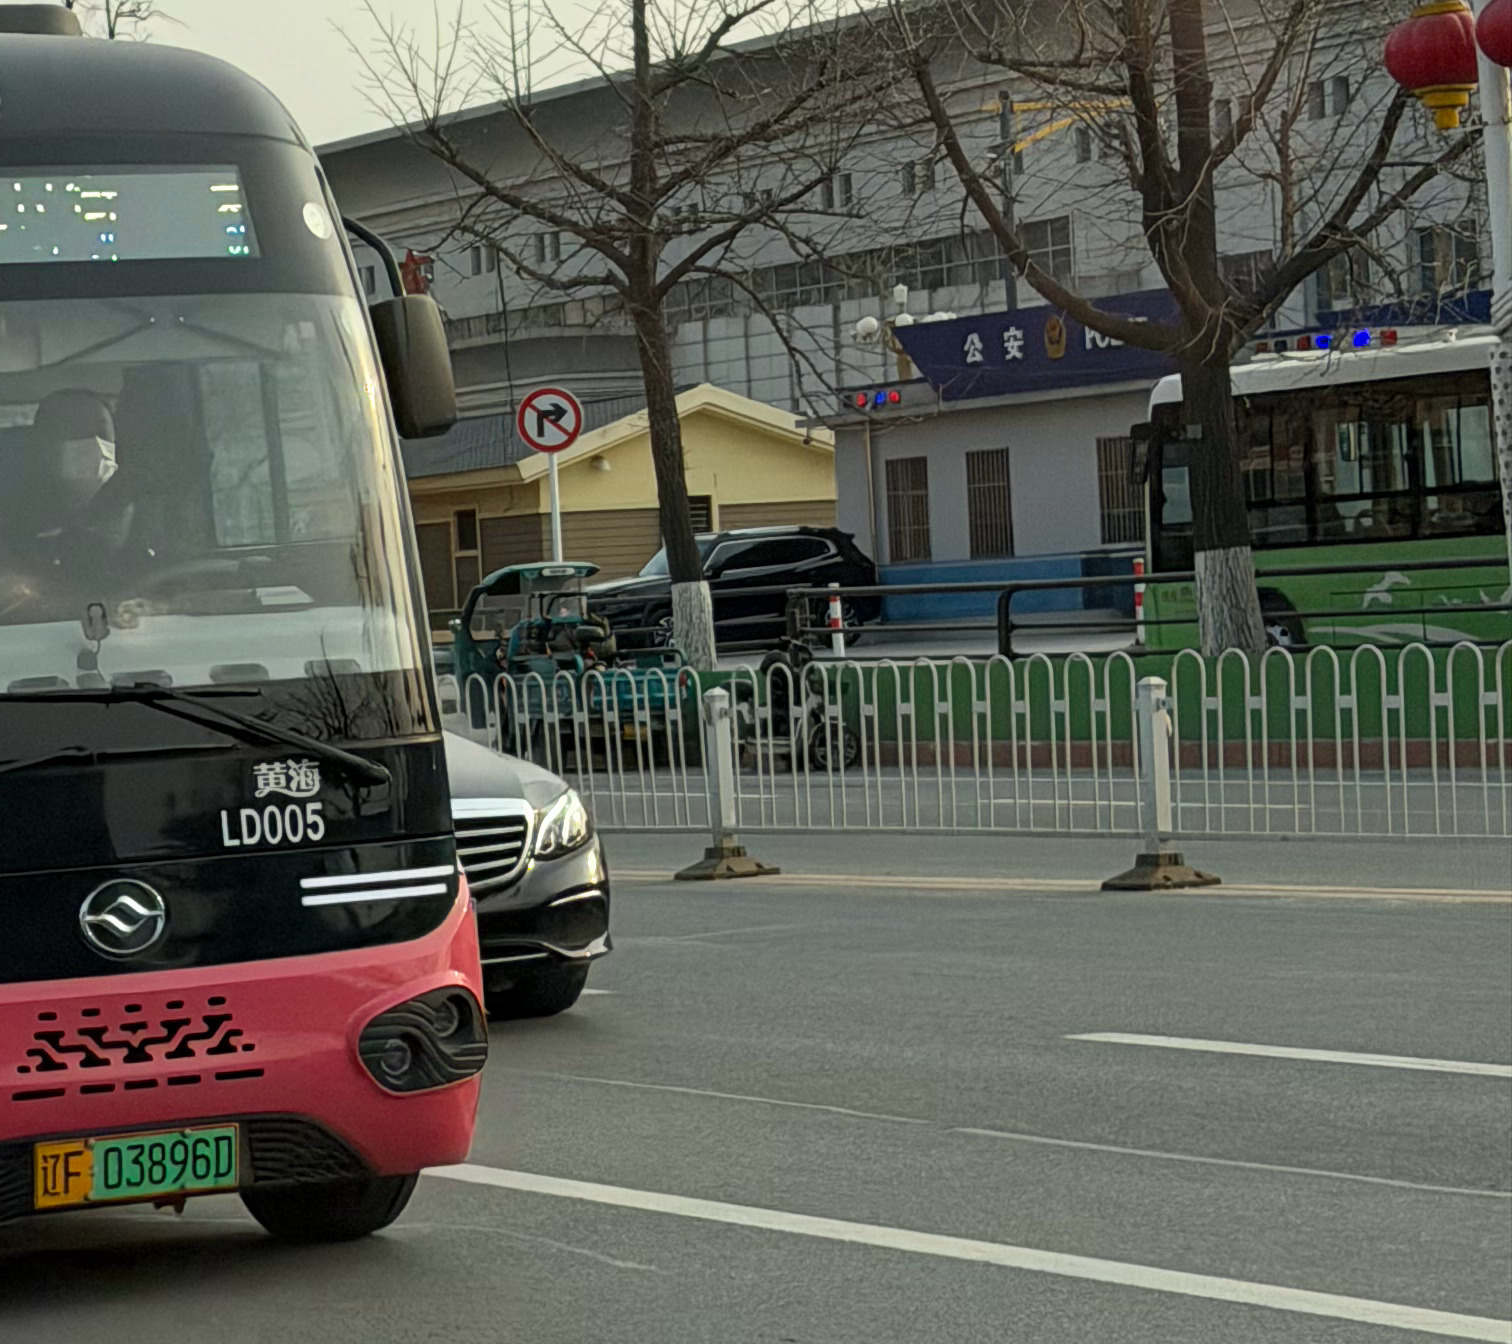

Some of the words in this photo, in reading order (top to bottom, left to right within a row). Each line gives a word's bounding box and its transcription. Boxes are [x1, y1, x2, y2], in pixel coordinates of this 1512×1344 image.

[963, 326, 1025, 364] 公安
[253, 758, 322, 798] 黄海
[220, 801, 326, 847] LD005
[41, 1149, 85, 1198] 辽F
[103, 1134, 233, 1190] 03896D
